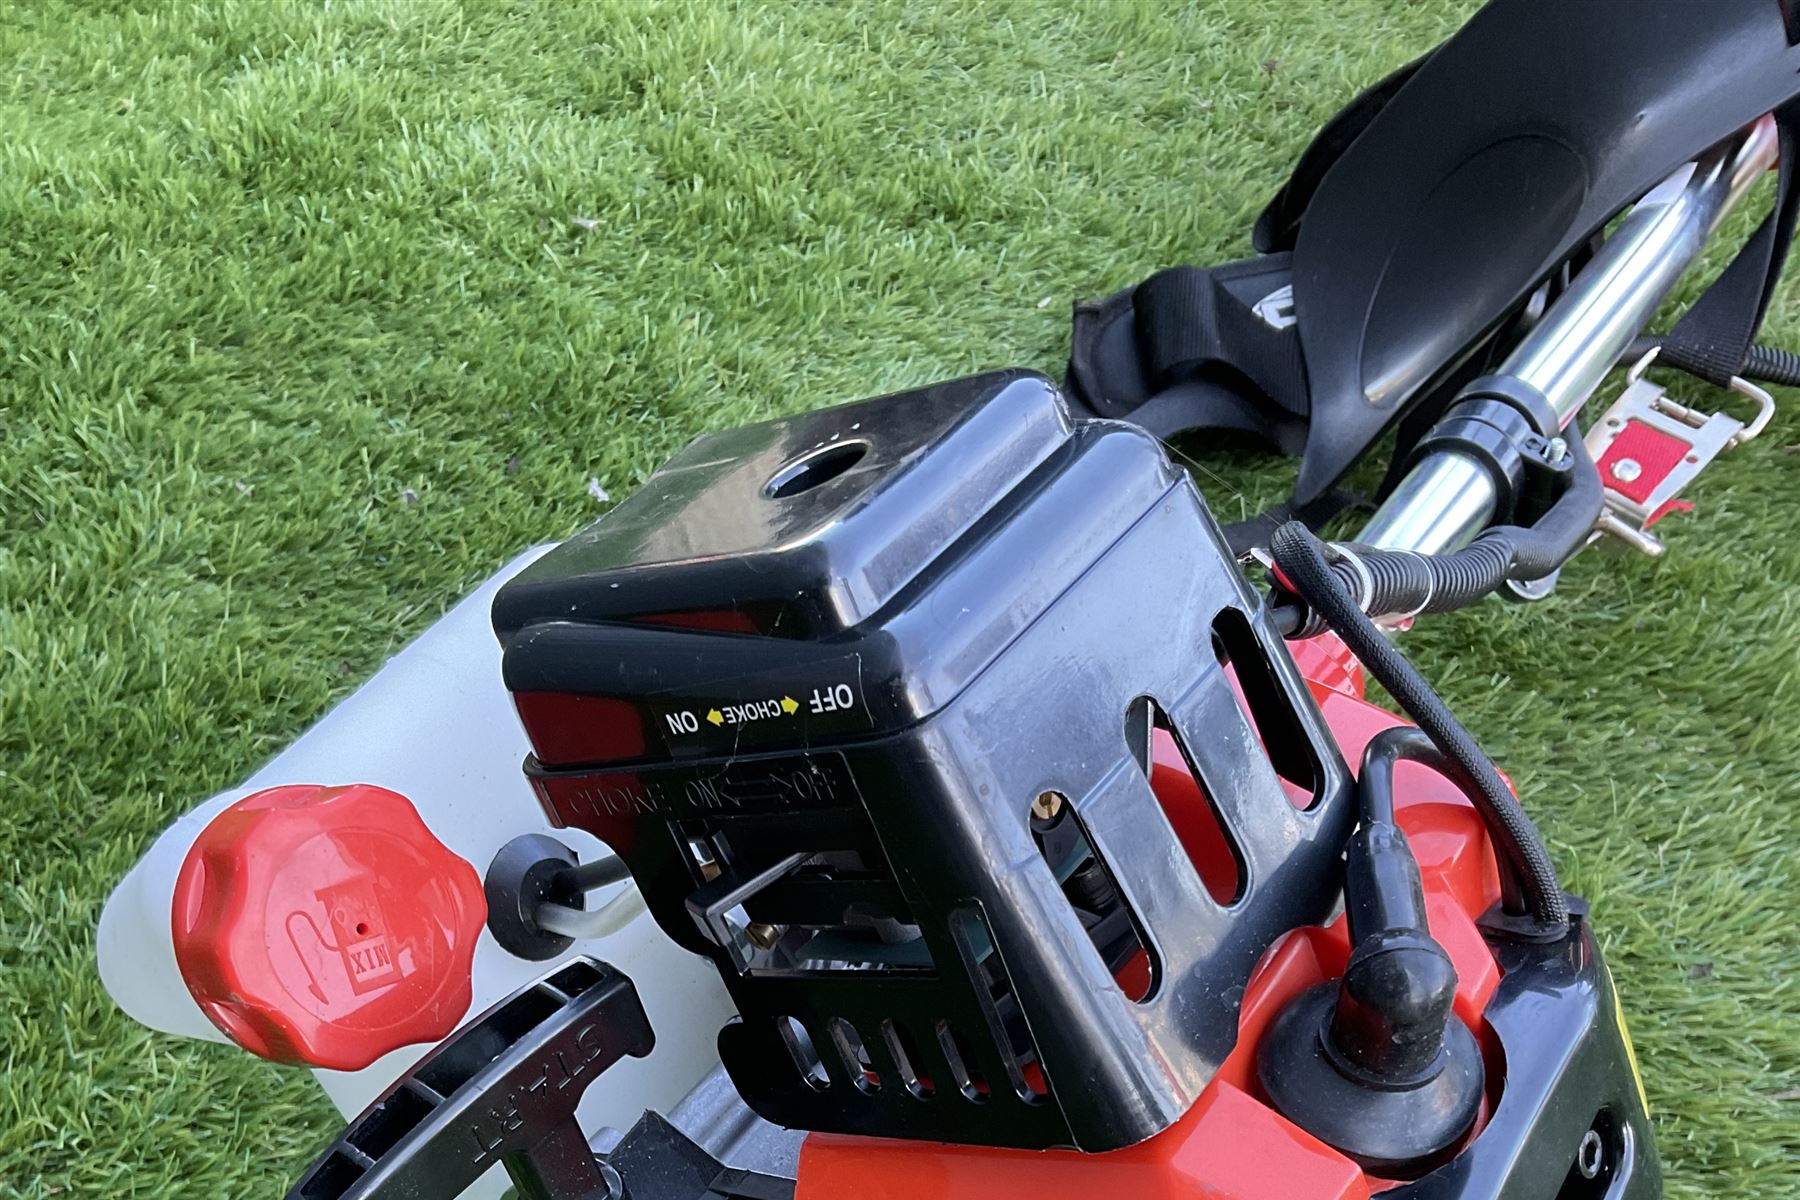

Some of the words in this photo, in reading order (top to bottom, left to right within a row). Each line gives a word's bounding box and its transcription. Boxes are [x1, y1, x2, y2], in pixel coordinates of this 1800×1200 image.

[722, 699, 782, 724] CHOKE
[809, 683, 855, 714] OFF
[665, 710, 700, 735] ON
[569, 783, 672, 818] CHOKE
[684, 777, 723, 808] ON
[791, 768, 838, 802] OFF
[350, 943, 391, 975] MIX
[472, 1023, 602, 1164] START
